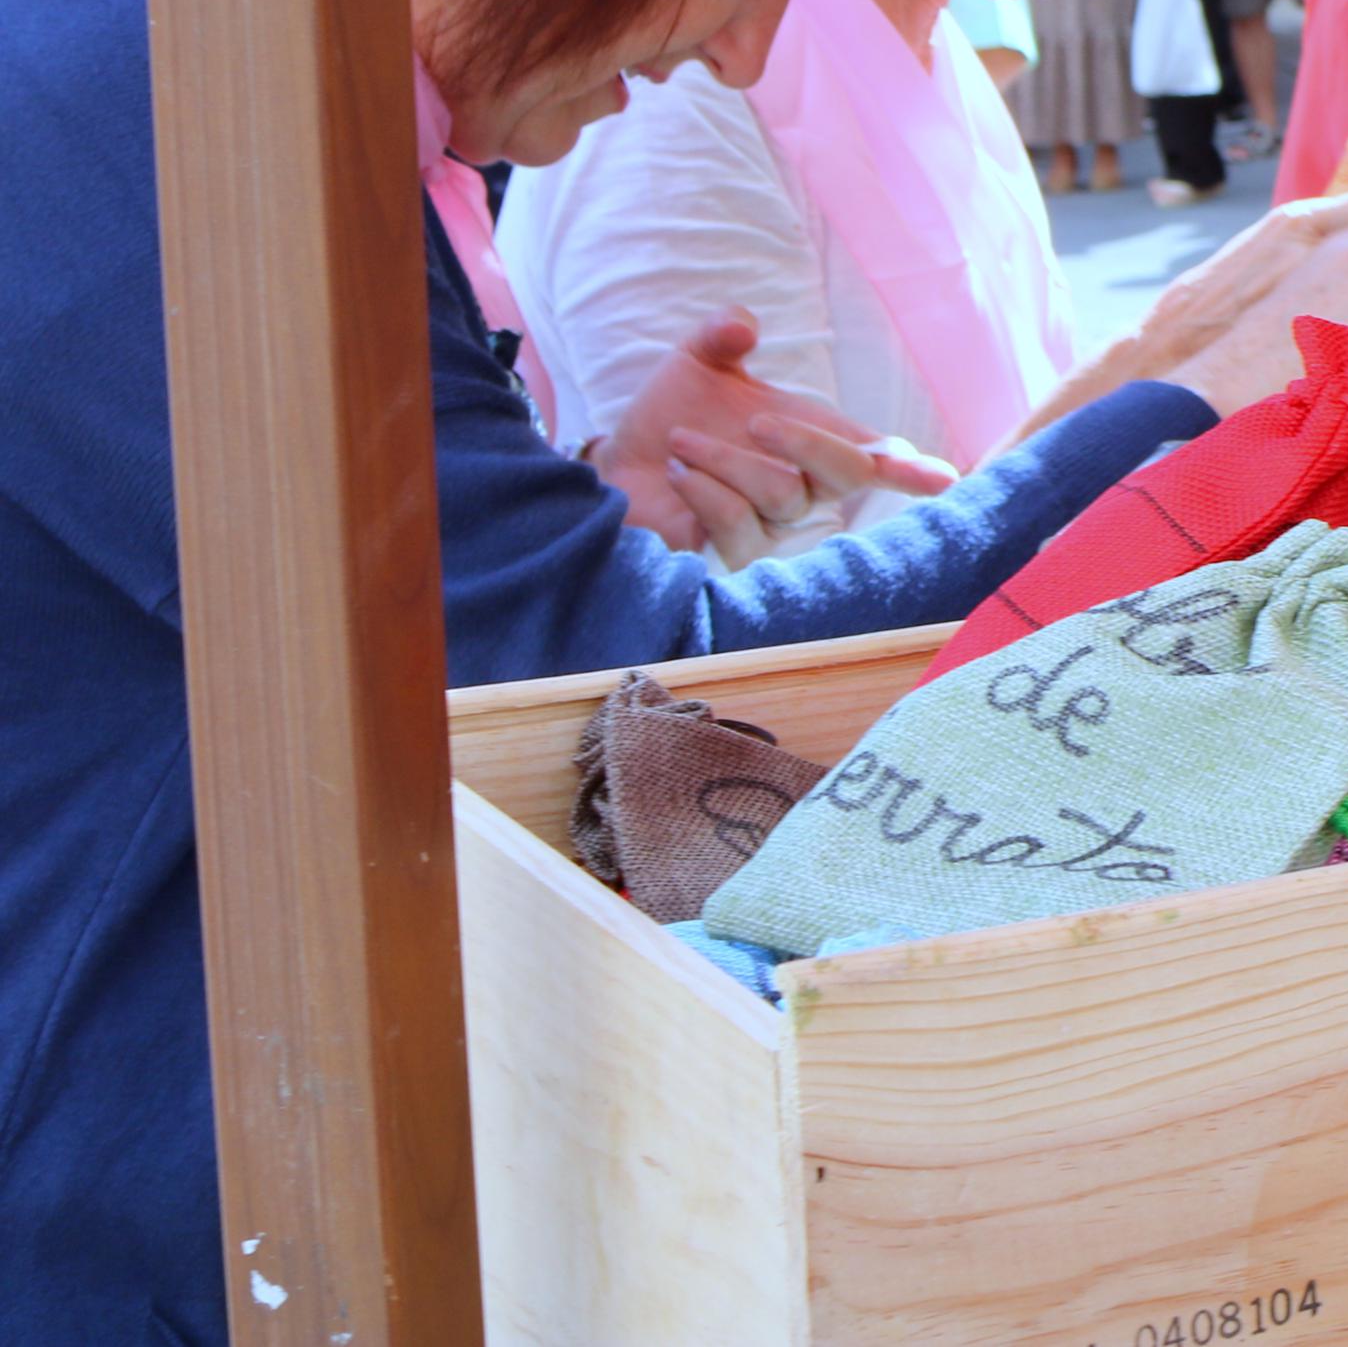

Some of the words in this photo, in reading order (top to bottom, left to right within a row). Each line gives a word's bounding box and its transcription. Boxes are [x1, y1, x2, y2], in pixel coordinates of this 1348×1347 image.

[986, 645, 1110, 758] de
[824, 750, 1180, 886] errato
[1135, 1279, 1322, 1347] 0408104
